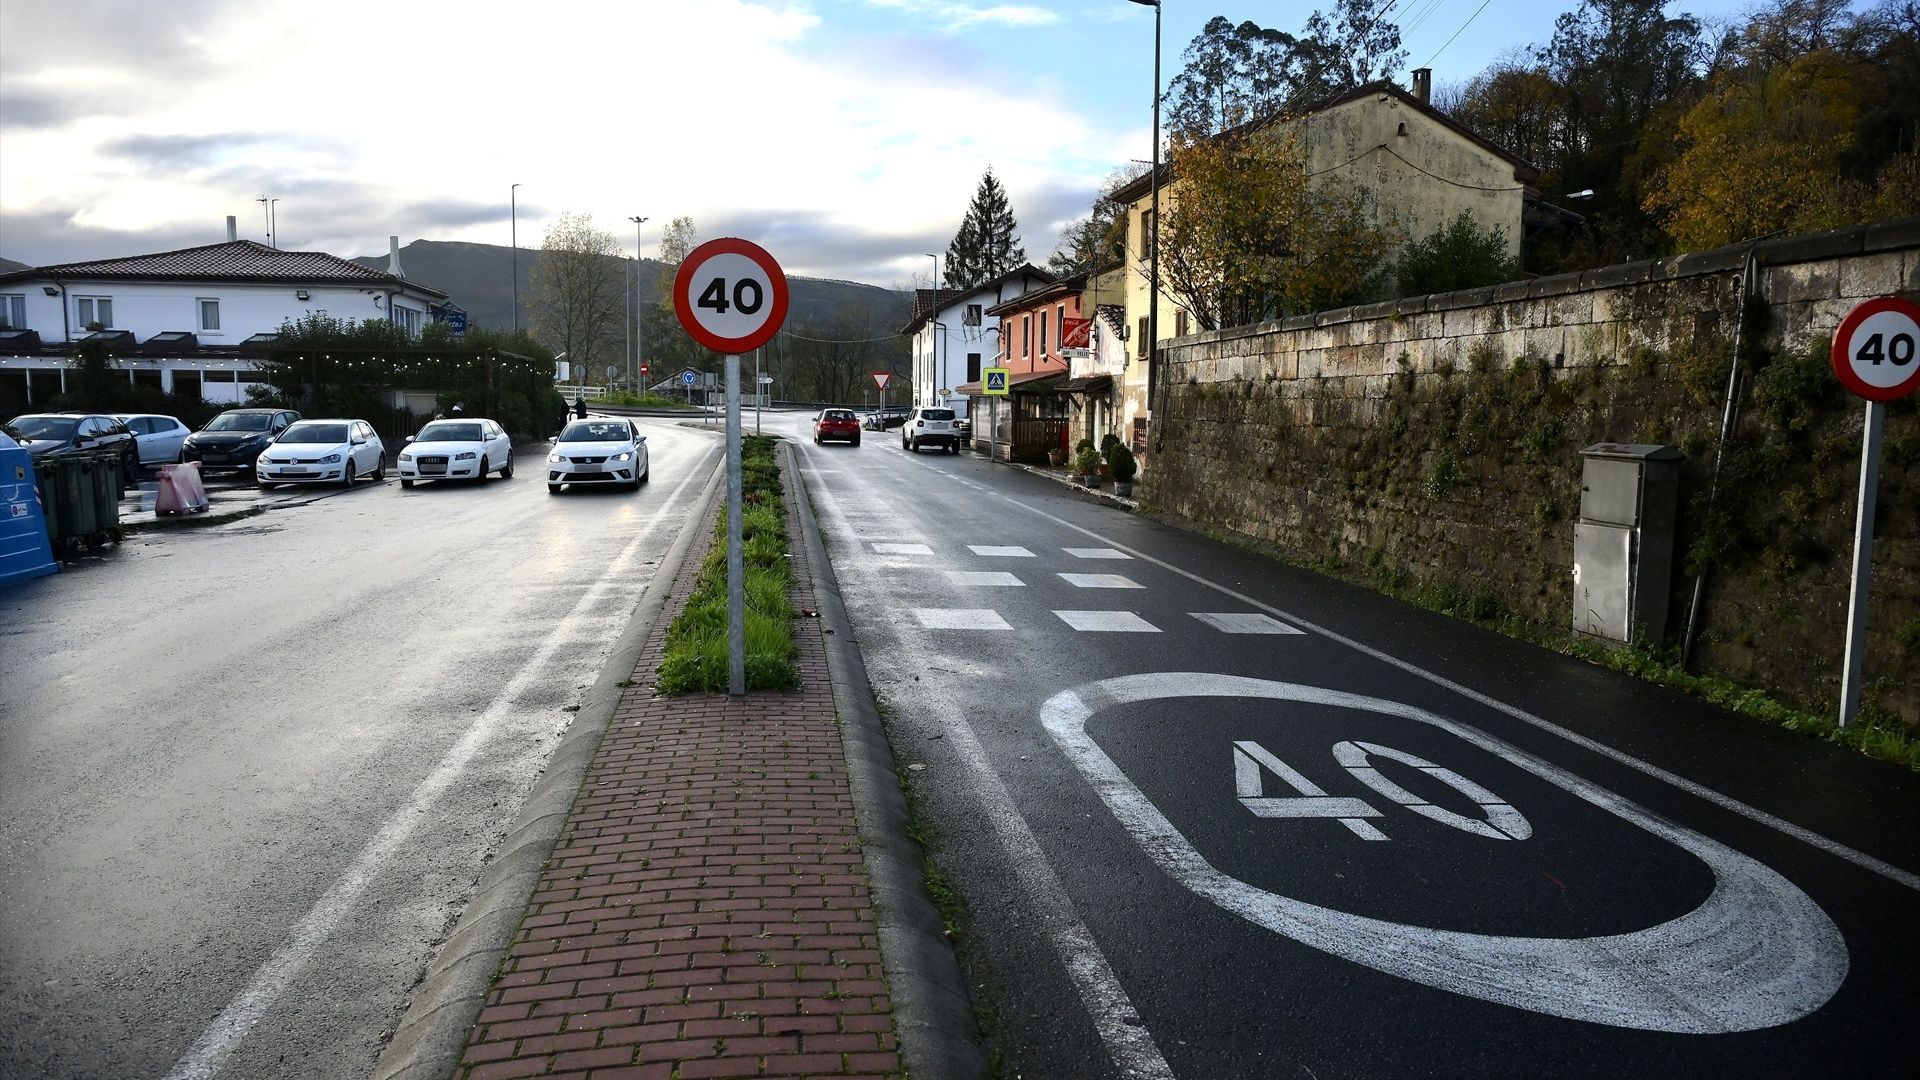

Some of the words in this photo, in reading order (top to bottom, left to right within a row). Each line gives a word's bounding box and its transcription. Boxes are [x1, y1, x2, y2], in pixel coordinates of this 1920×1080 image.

[698, 278, 763, 315] 40
[1856, 333, 1915, 366] 40
[1233, 740, 1533, 842] 40
